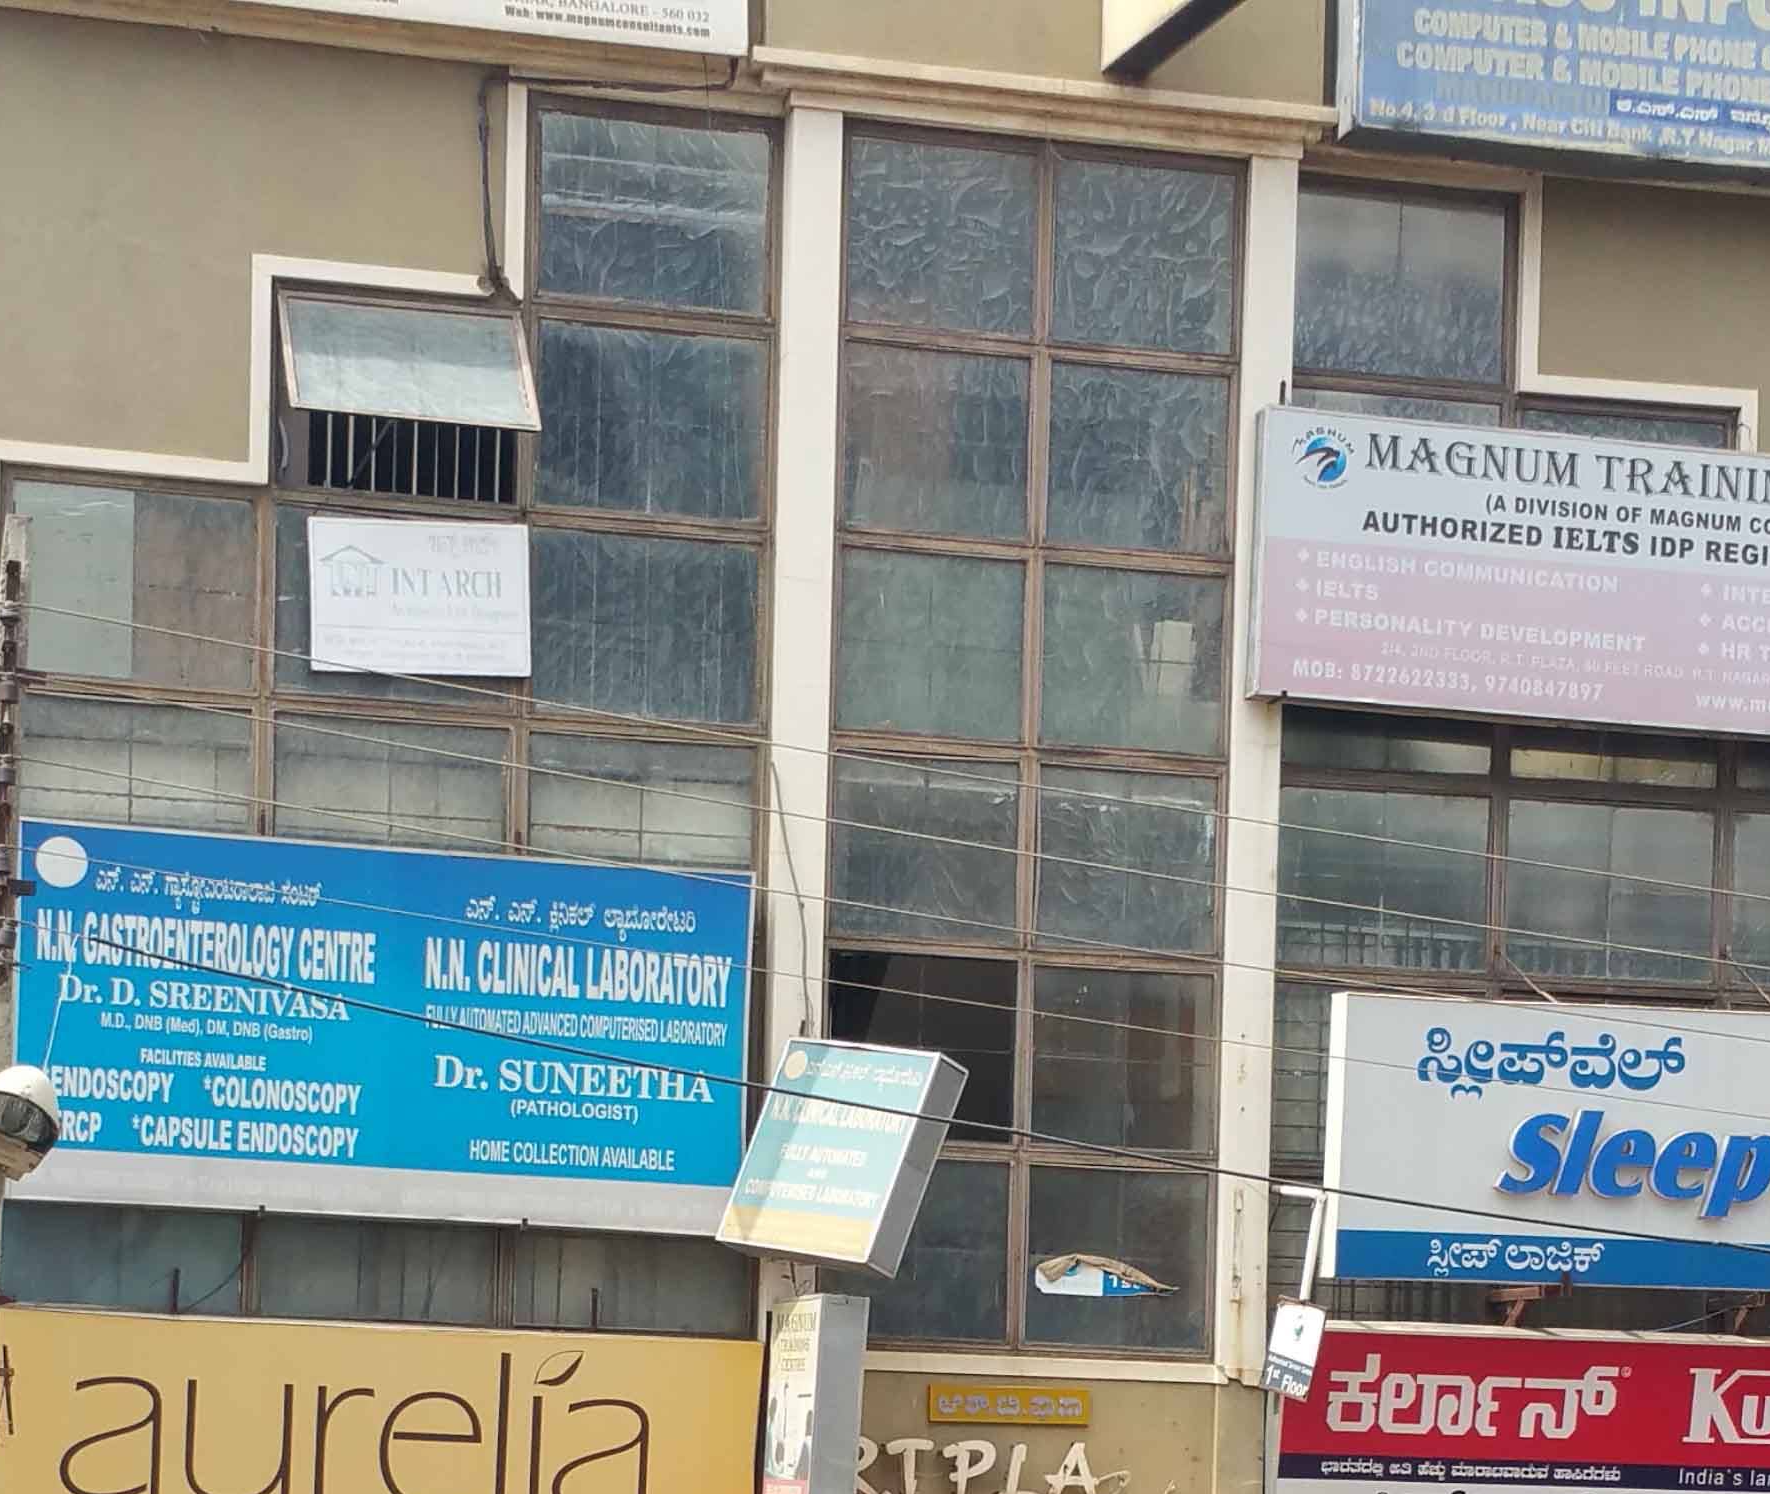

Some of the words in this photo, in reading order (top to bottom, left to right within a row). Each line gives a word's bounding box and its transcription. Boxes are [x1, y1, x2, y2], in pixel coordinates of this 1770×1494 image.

[1414, 8, 1547, 45] COMPUTER
[1554, 22, 1572, 49] &
[1579, 24, 1670, 60] MOBILE
[1675, 36, 1756, 69] PHONE
[1397, 41, 1544, 80] COMPUTER
[1552, 55, 1571, 83] &
[1579, 58, 1680, 93] MOBILE
[1365, 432, 1580, 488] MAGNUM
[1363, 510, 1542, 548] AUTHORIZED
[1552, 527, 1641, 555] IELTS
[1650, 536, 1694, 560] IDP
[1486, 493, 1507, 515] (A
[1515, 497, 1608, 522] DIVISION
[1616, 505, 1643, 526] OF
[1650, 508, 1742, 534] MAGNUM
[1317, 550, 1416, 574] ENGLISH
[1425, 560, 1619, 594] COMMUNICATION
[1317, 579, 1380, 602] IELTS
[1315, 608, 1472, 638] PERSONALITY
[1481, 622, 1647, 654] DEVELOPMENT
[1722, 643, 1751, 661] HR
[36, 908, 77, 963] N.N.
[82, 911, 295, 979] GASTROENTEROLOGY
[299, 927, 377, 985] CENTRE
[425, 936, 471, 992] N.N.
[477, 939, 580, 999] CLINICAL
[585, 946, 732, 1009] LABORATORY
[58, 973, 103, 1005] Dr.
[111, 977, 142, 1007] D.
[149, 980, 351, 1021] SREENIVASA
[134, 1014, 163, 1031] DNB
[233, 1020, 260, 1037] DNB
[263, 1022, 314, 1045] (Gastro)
[459, 1006, 521, 1036] AUTOMATED
[522, 1011, 578, 1039] ADVANCED
[580, 1014, 658, 1043] COMPUTERISED
[660, 1021, 728, 1048] LABORATORY
[140, 1047, 202, 1067] FACILITIES
[204, 1051, 267, 1072] AVAILABLE
[433, 1054, 489, 1091] Dr.
[498, 1058, 715, 1104] SUNEETHA
[510, 1098, 640, 1126] (PATHOLOGIST)
[237, 1120, 360, 1159] ENDOSCOPY
[469, 1138, 510, 1163] HOME
[513, 1141, 599, 1168] COLLECTION
[601, 1145, 676, 1172] AVAILABLE
